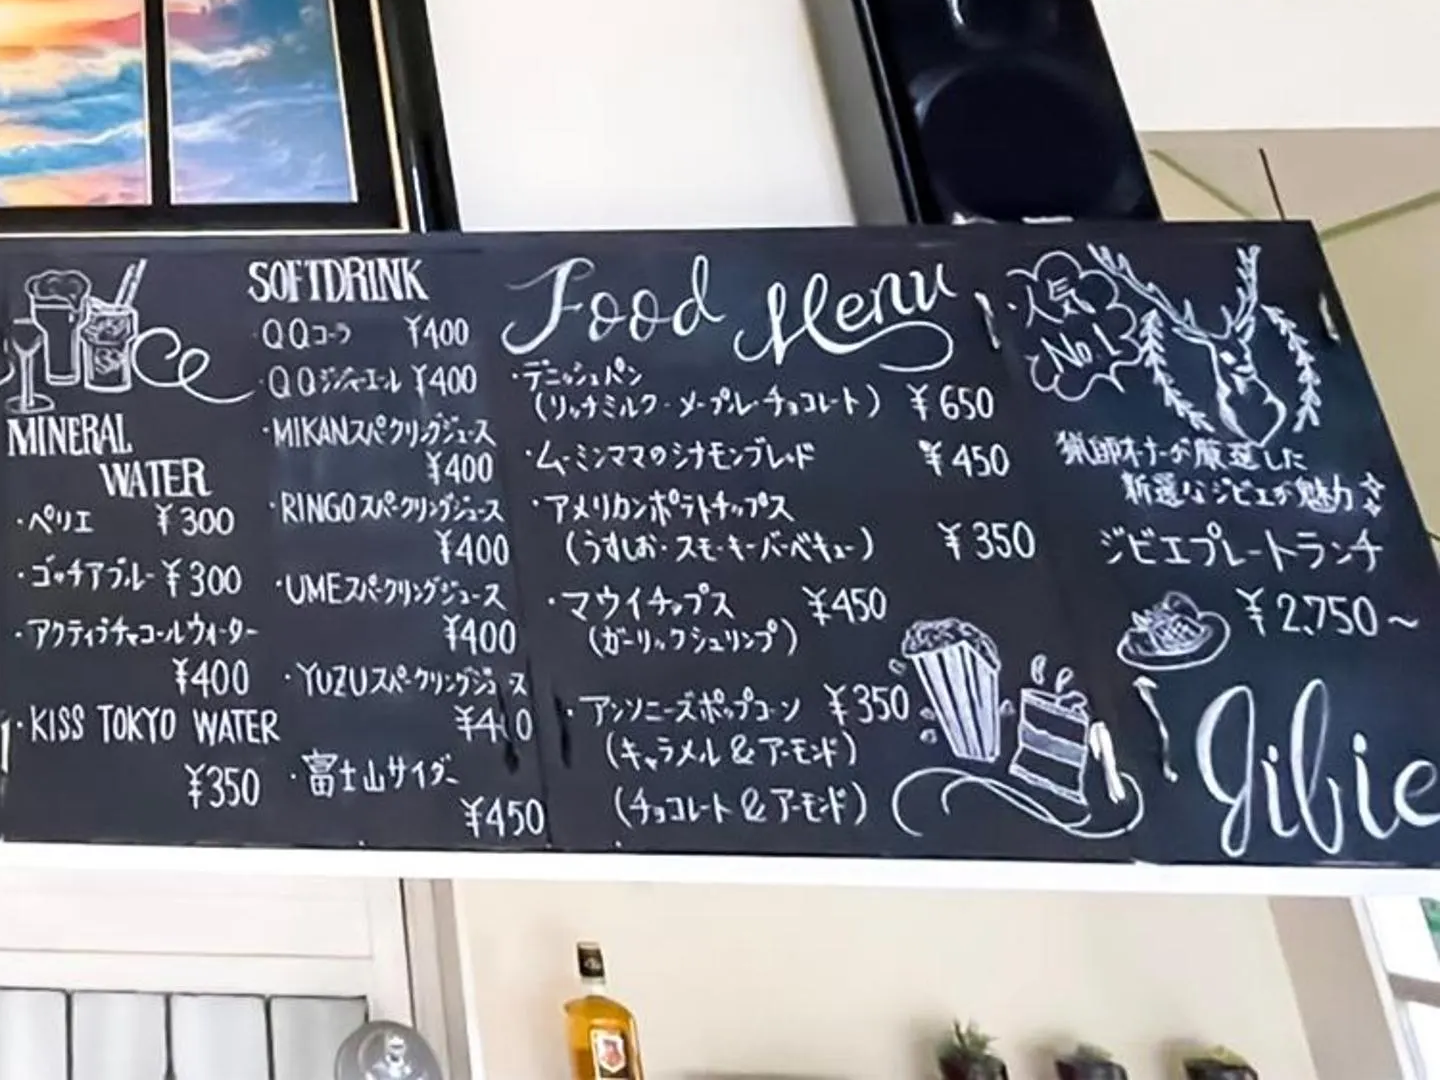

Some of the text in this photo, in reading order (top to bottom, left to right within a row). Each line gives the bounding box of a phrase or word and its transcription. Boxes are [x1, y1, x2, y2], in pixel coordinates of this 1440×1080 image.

[404, 313, 470, 350] ¥400
[500, 254, 958, 373] Food Menu
[410, 362, 478, 400] ¥400
[6, 413, 133, 457] MINERAL
[99, 457, 213, 499] WATER
[425, 449, 494, 487] ¥400
[28, 502, 235, 536] ペリエ ¥300
[434, 528, 510, 566] ¥400
[1100, 521, 1384, 573] ジビエプレートランチ
[160, 556, 242, 599] ¥300
[561, 582, 888, 626] マウイチップス ¥450
[442, 613, 516, 656] ¥400
[172, 656, 251, 699] ¥400
[29, 703, 281, 746] KISS TOKYO WATER
[823, 682, 910, 726] ¥350
[185, 763, 260, 810] ¥350
[301, 748, 460, 799] 富士山サイダー
[460, 796, 545, 838] ¥450
